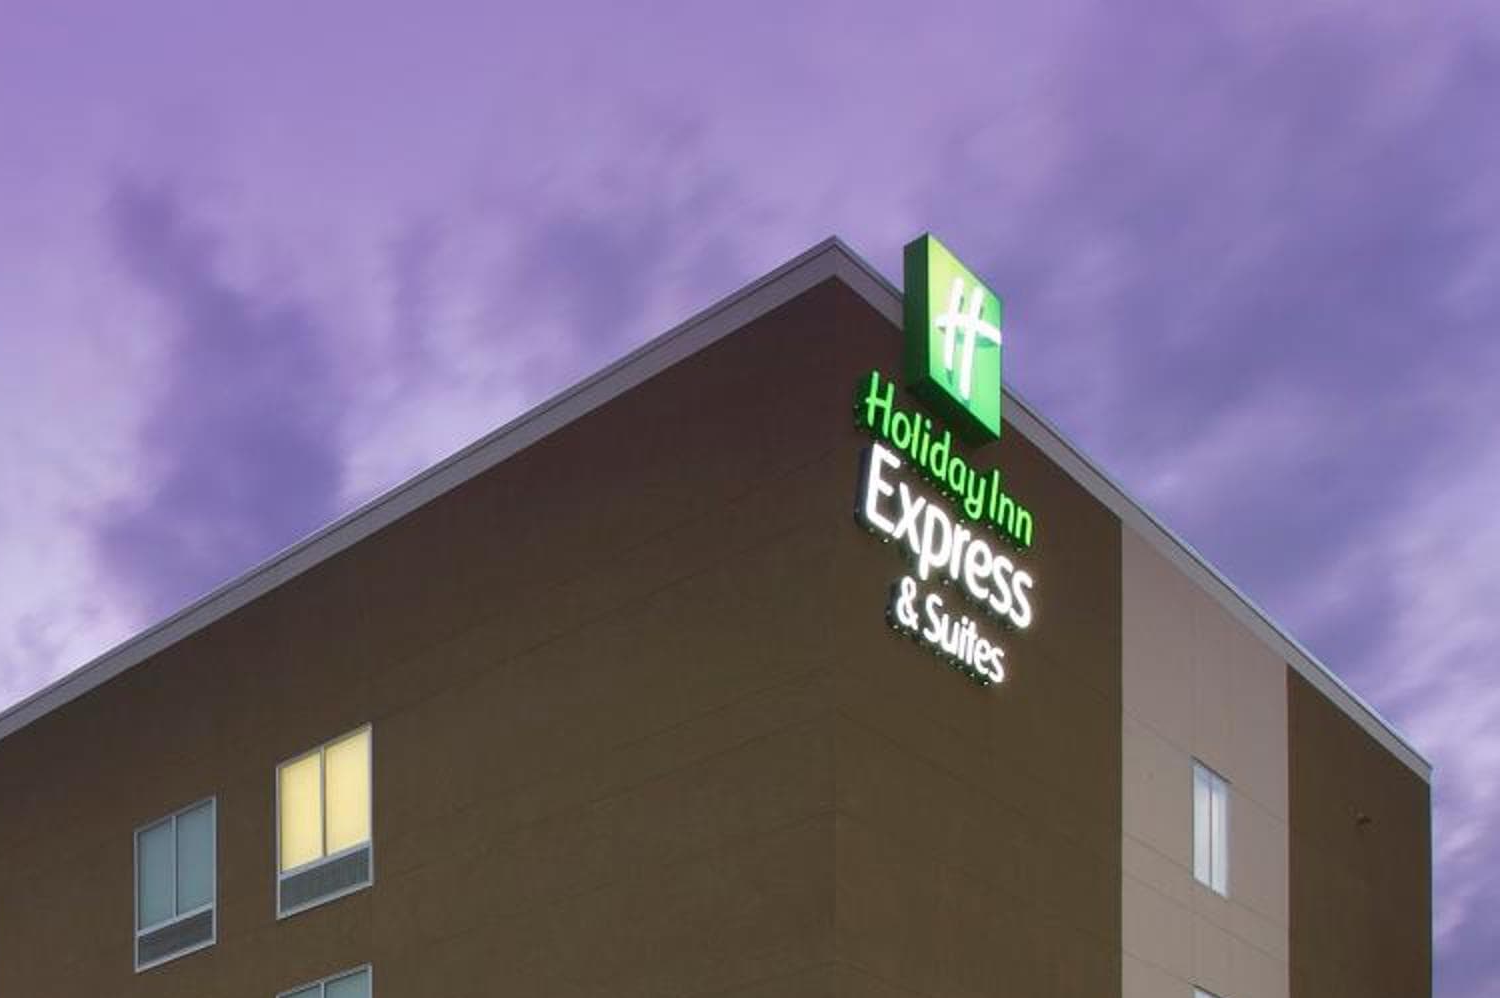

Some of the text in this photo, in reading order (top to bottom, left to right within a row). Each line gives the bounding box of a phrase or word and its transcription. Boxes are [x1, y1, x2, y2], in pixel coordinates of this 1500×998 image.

[865, 370, 1034, 548] Holiday Inn
[865, 442, 1033, 629] Express
[895, 575, 1005, 683] & Suites
